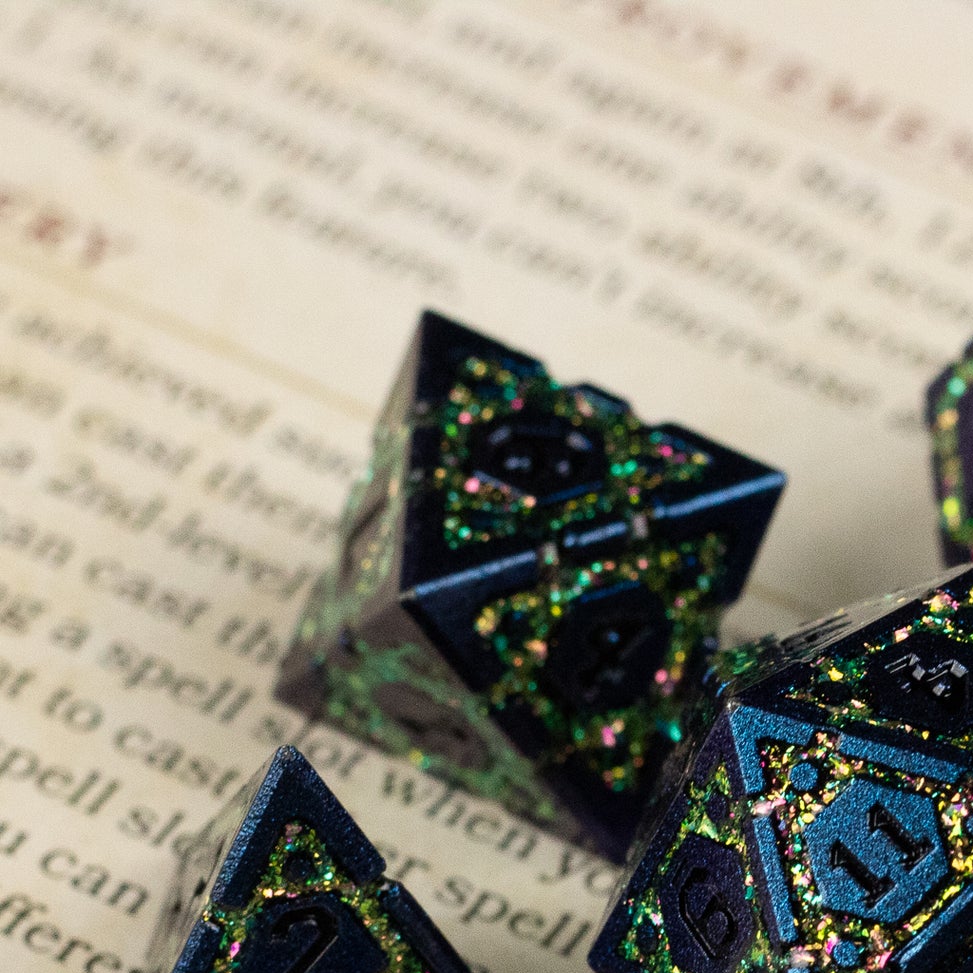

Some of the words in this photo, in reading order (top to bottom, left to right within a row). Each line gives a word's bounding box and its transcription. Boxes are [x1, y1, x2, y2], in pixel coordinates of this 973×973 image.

[98, 641, 254, 725] spell
[43, 686, 105, 734] to
[113, 724, 241, 797] cast
[434, 873, 592, 957] spell
[829, 801, 934, 902] 11
[39, 847, 150, 917] can
